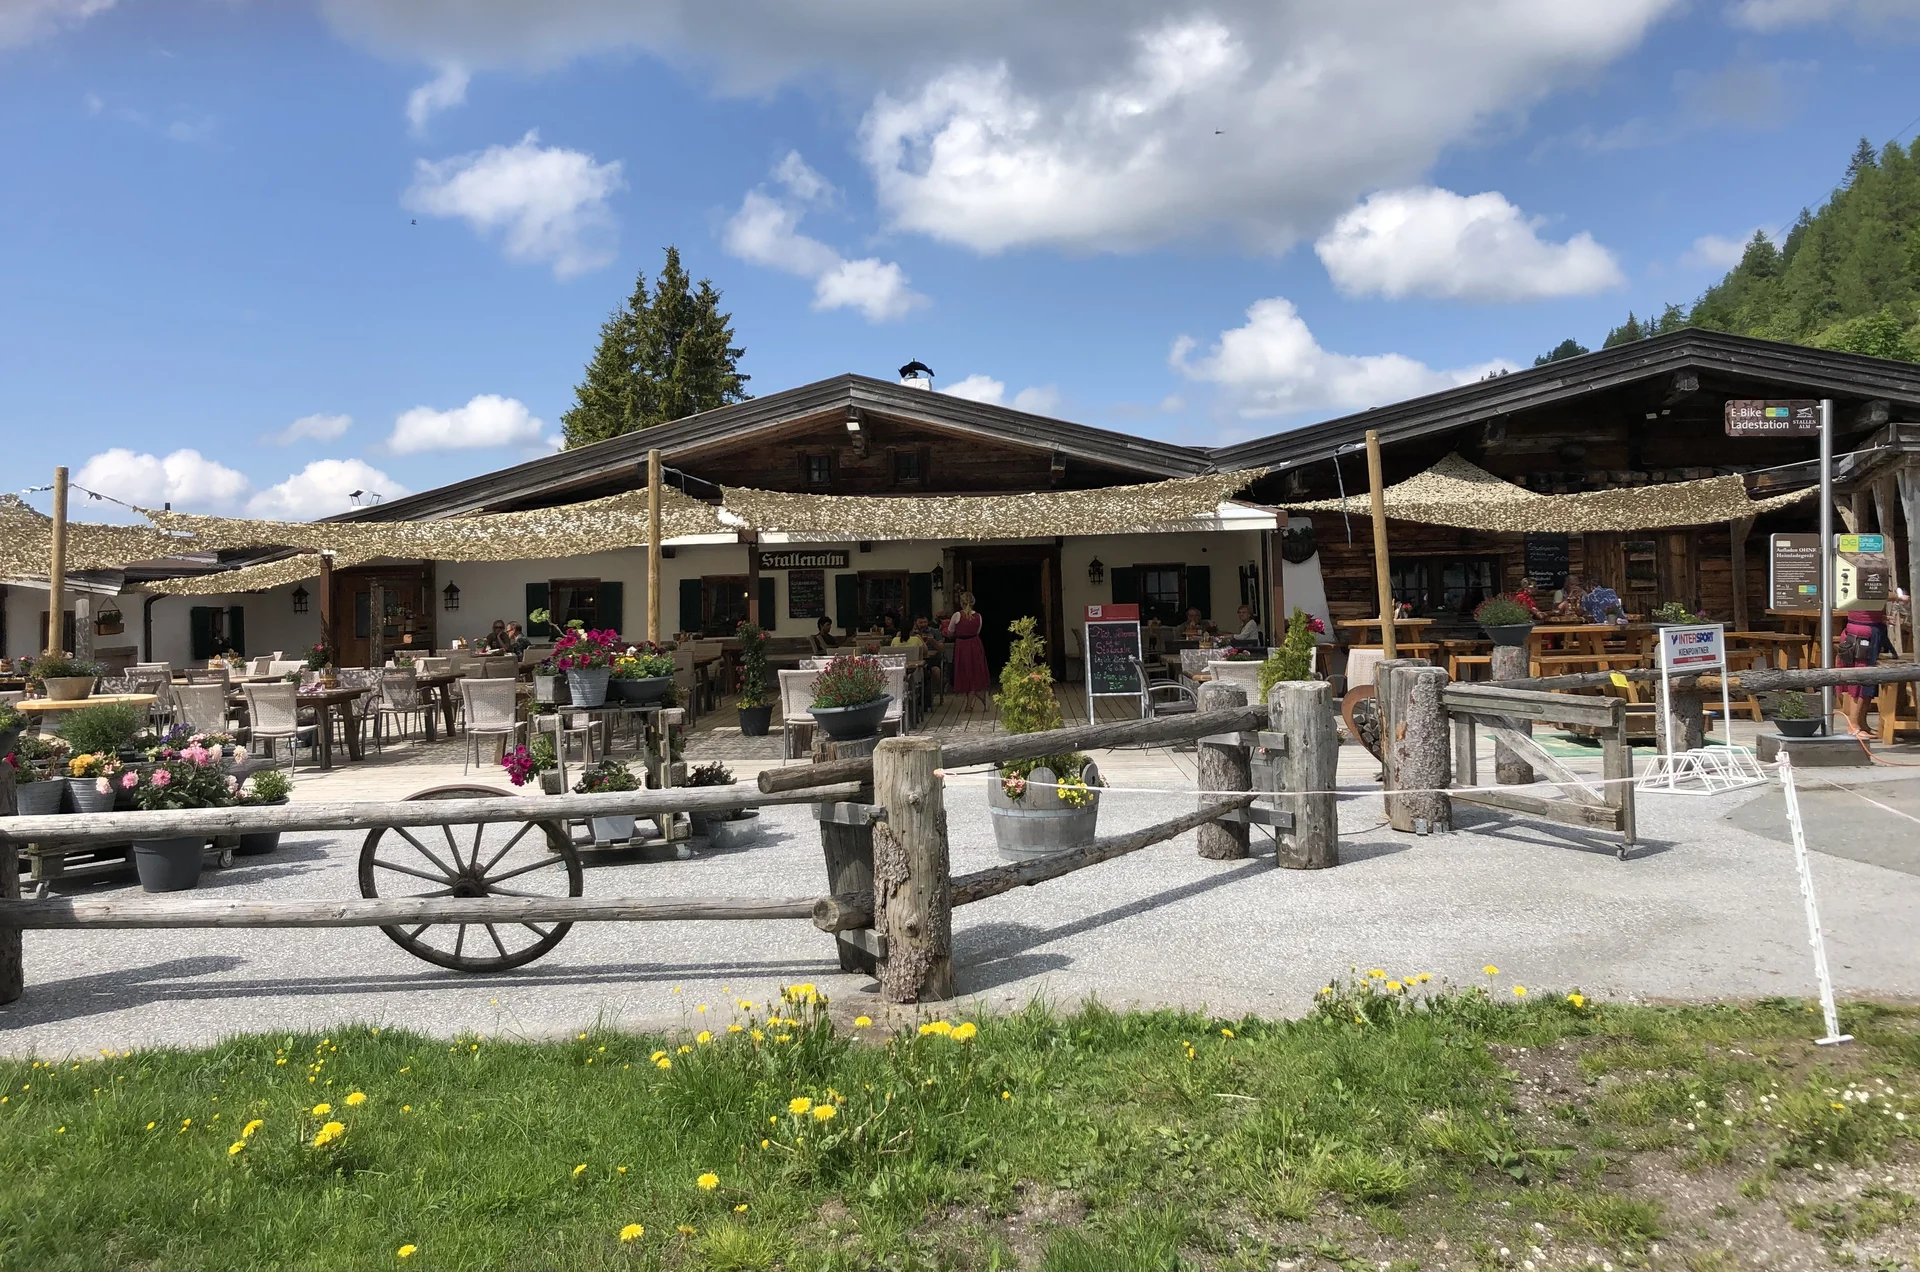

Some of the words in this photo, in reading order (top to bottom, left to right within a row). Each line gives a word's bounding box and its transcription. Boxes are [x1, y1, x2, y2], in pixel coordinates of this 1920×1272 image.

[1731, 408, 1762, 417] E-Bike
[1731, 420, 1789, 429] Ladestation
[761, 552, 845, 567] Stallenalm
[1679, 632, 1714, 644] INTERSPORT
[1679, 646, 1709, 656] KIENPOINTNER
